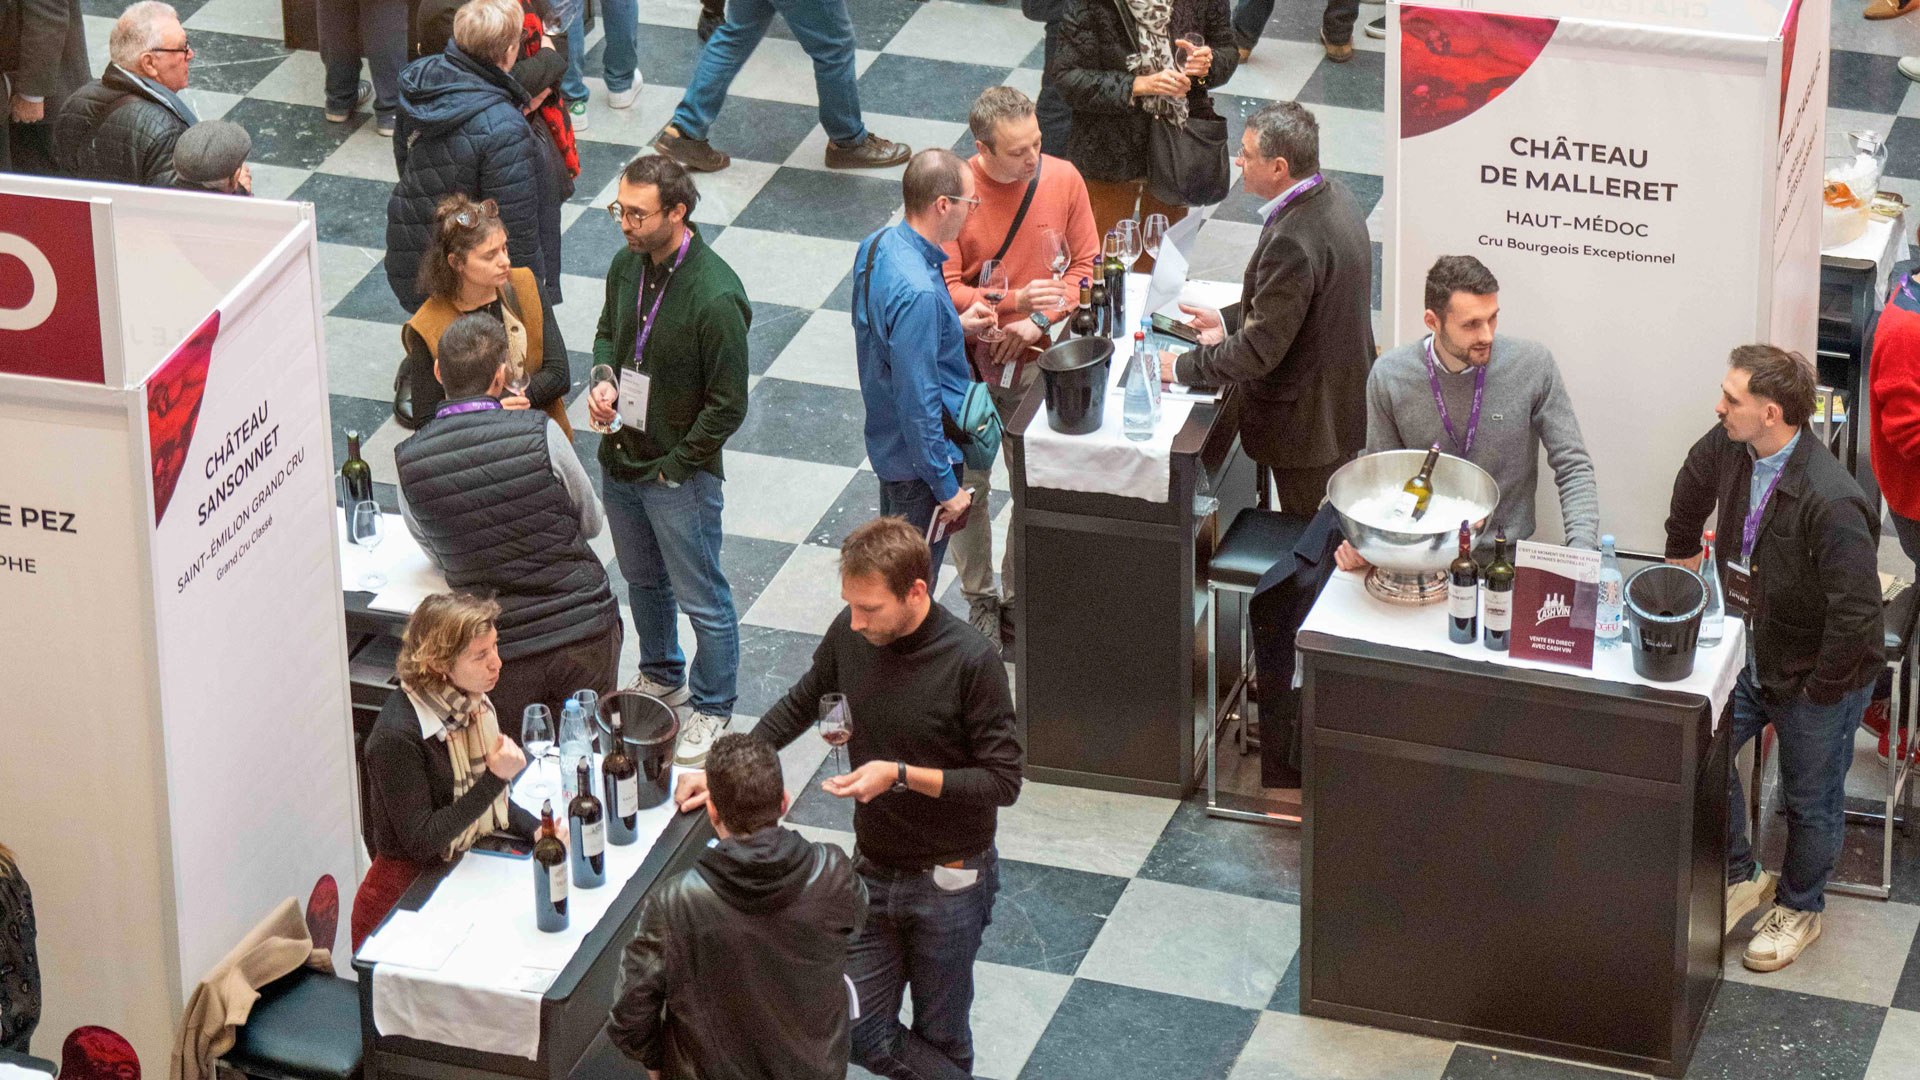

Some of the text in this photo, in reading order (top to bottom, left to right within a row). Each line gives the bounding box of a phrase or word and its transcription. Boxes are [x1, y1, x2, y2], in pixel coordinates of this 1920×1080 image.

[1510, 136, 1648, 168] CHÂTEAU
[1480, 165, 1678, 202] DE MALLERET
[1506, 210, 1649, 237] HAUT-MÉDOC
[1478, 235, 1675, 264] Cru Bourgeois Exceptionnel
[205, 400, 269, 480] CHÂTEAU
[198, 424, 279, 526] SANSONNET
[21, 507, 77, 534] PEZ
[177, 446, 305, 594] SAINT-ÉMILION GRAND CRU
[216, 515, 273, 581] Grand Cru Classé
[1556, 605, 1571, 618] VIN
